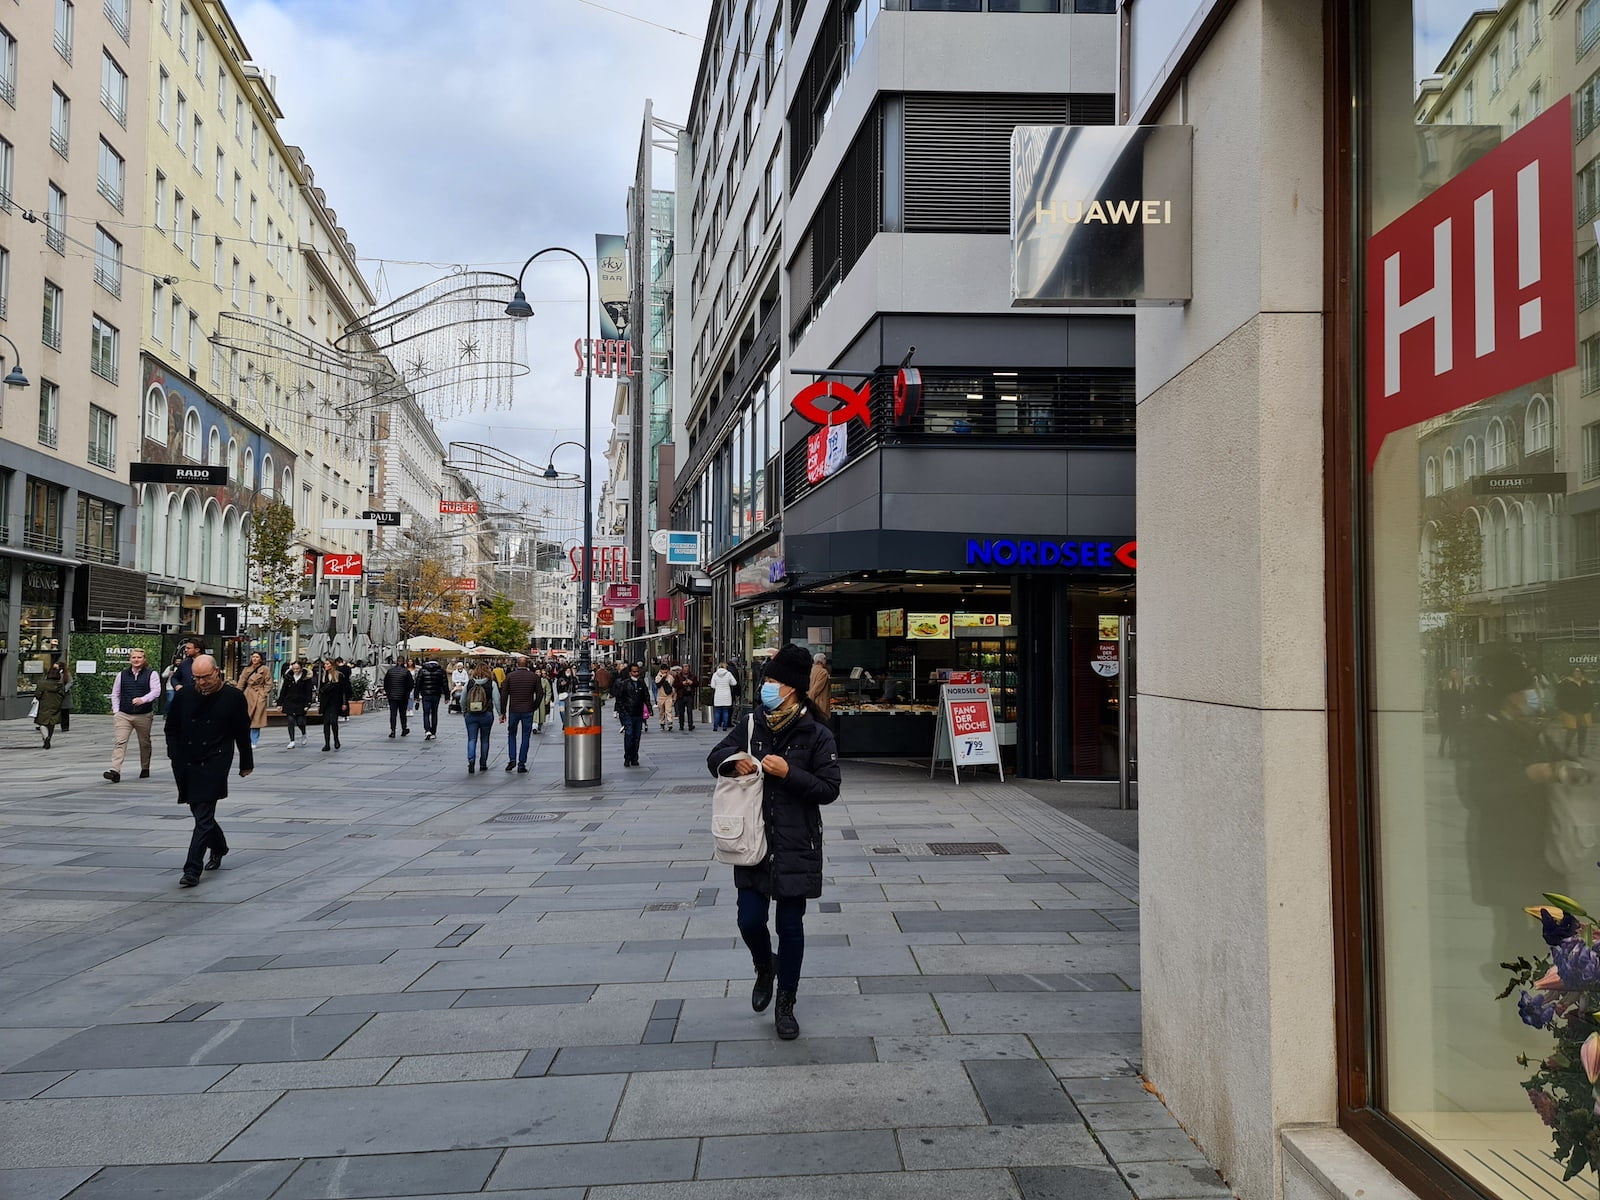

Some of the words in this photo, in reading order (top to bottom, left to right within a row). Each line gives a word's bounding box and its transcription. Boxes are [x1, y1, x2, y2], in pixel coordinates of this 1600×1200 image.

[1035, 200, 1171, 224] HUAWEI
[601, 256, 623, 270] sky
[1384, 159, 1542, 398] HI!
[176, 469, 209, 477] RADO
[441, 502, 474, 513] HUBER
[370, 513, 394, 521] PAUL
[966, 539, 1113, 567] NORDSEE
[325, 555, 361, 573] Ray-Ban
[569, 546, 630, 582] STEFFL
[947, 687, 976, 695] NORDSEE
[953, 705, 976, 715] FANG
[955, 714, 972, 724] DER
[956, 720, 988, 731] WOCHE
